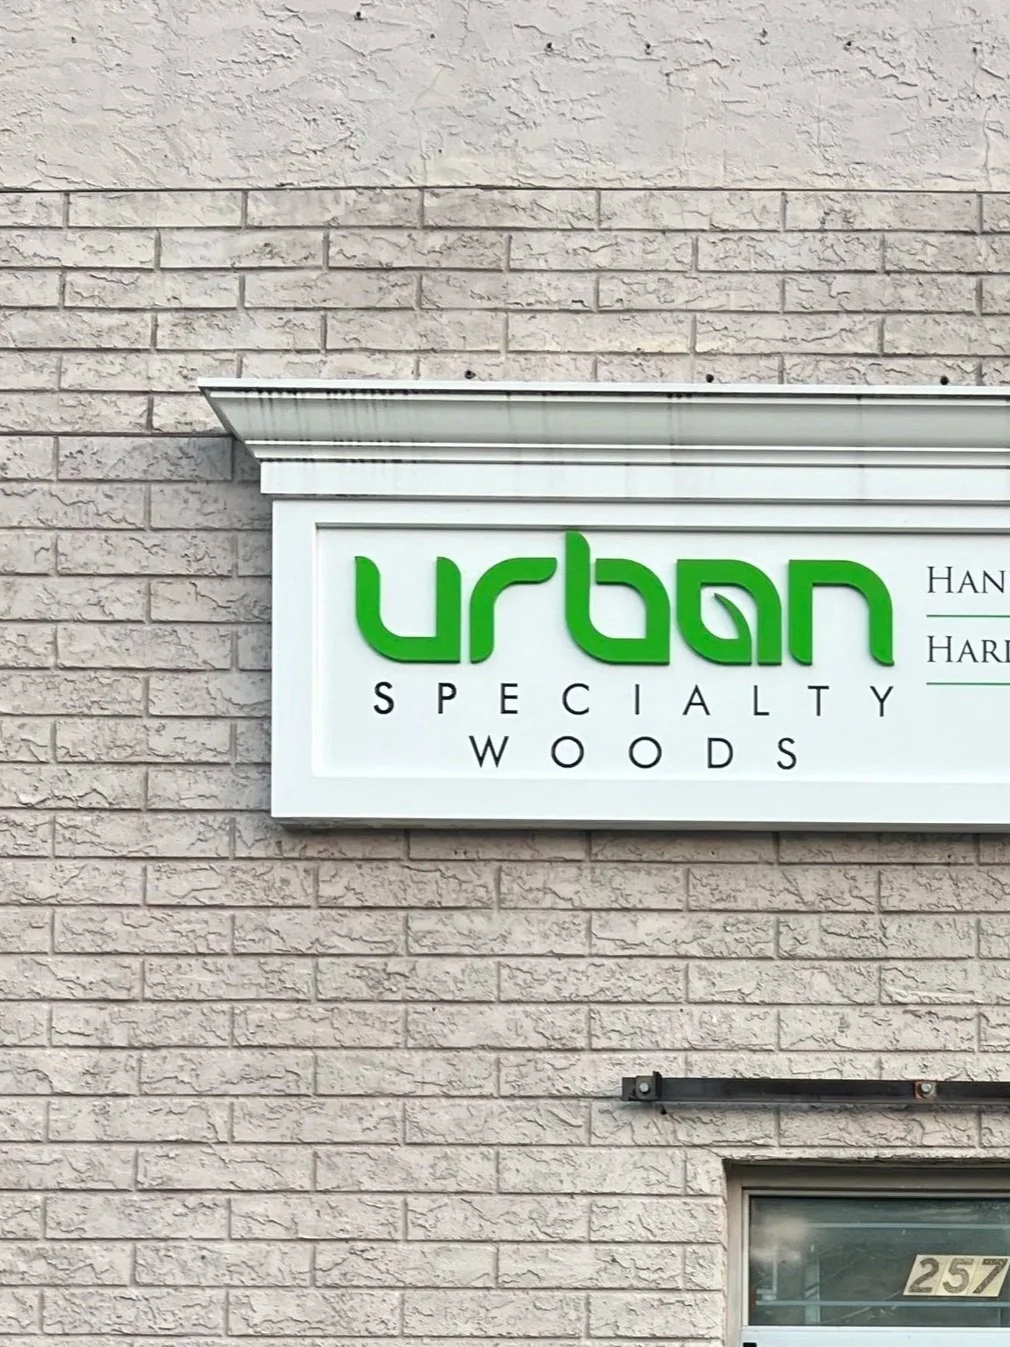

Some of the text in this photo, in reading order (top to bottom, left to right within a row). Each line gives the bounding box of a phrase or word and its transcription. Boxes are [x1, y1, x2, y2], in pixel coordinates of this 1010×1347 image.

[355, 530, 895, 667] urban
[373, 681, 894, 717] SPECIALTY
[468, 735, 797, 770] WOODS
[908, 1257, 1008, 1294] 257
